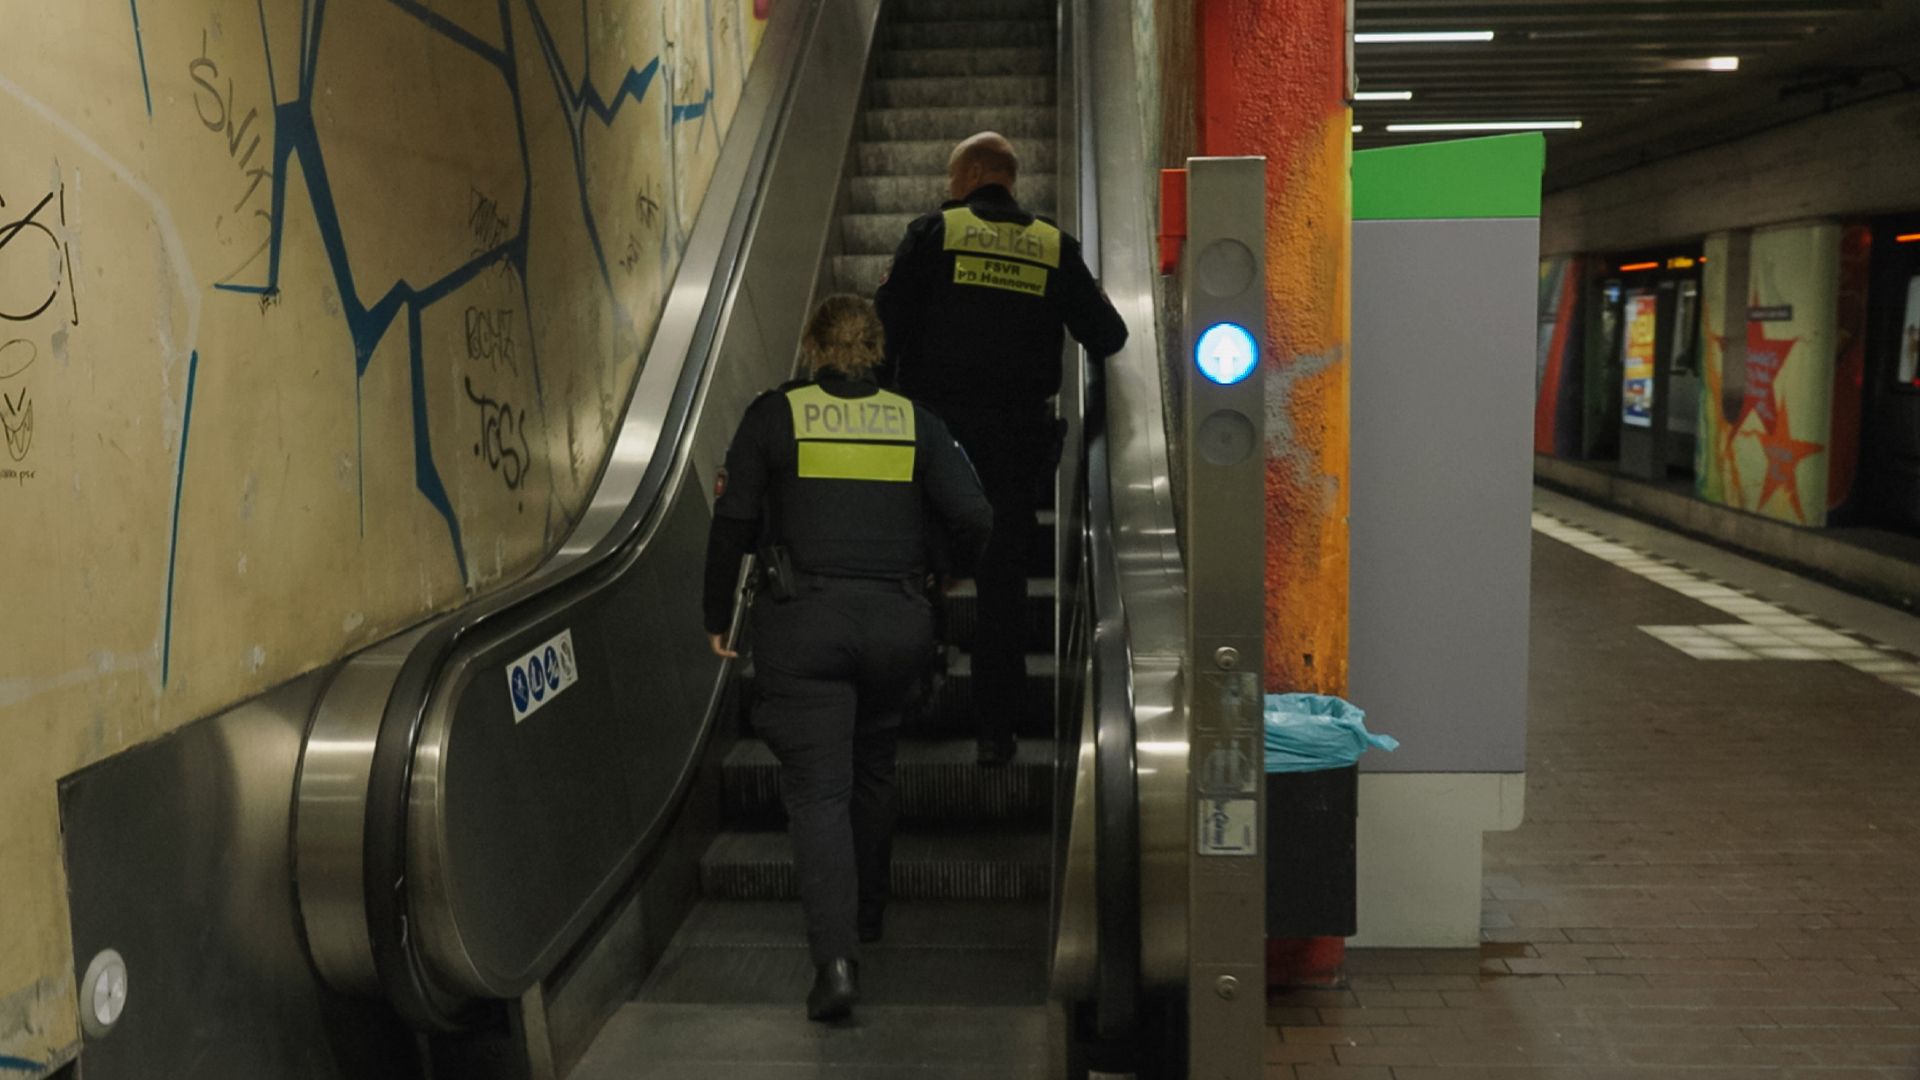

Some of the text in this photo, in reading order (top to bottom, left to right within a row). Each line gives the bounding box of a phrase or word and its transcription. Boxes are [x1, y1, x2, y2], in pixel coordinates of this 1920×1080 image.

[964, 225, 1044, 258] POLIZEI
[957, 270, 1043, 291] PD Hannover
[984, 261, 1020, 275] FSVR
[804, 403, 907, 434] POLIZEI
